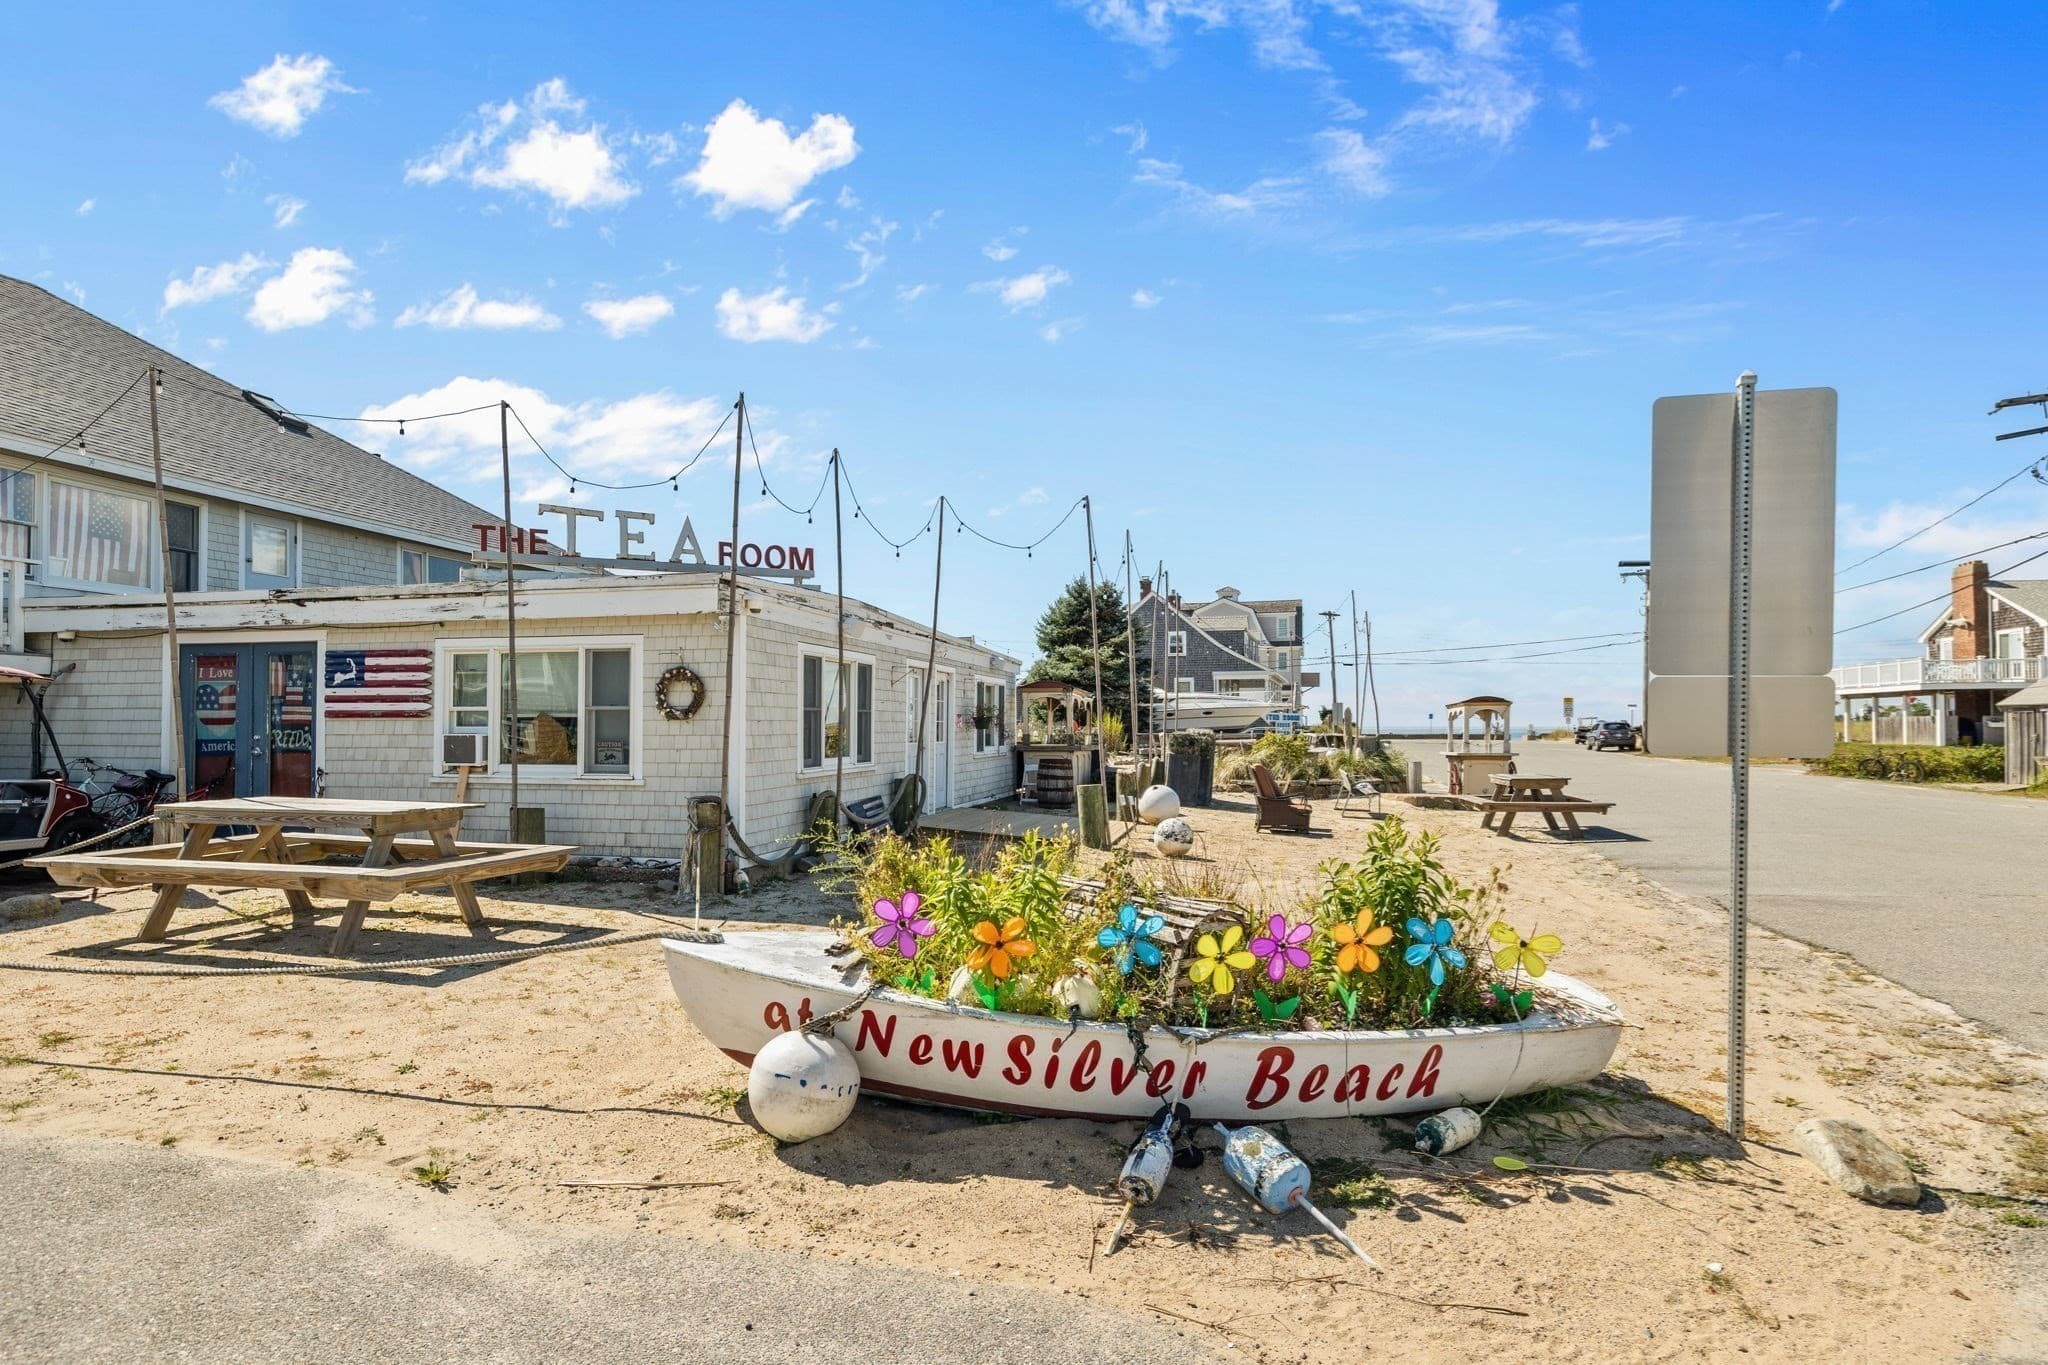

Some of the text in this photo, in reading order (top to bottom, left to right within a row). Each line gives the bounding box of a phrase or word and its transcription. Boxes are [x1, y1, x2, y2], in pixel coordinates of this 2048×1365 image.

[472, 503, 814, 571] THE TEA ROOM
[199, 667, 233, 678] I Love
[201, 741, 236, 752] Americ
[764, 997, 1444, 1110] at New Silver Beach
